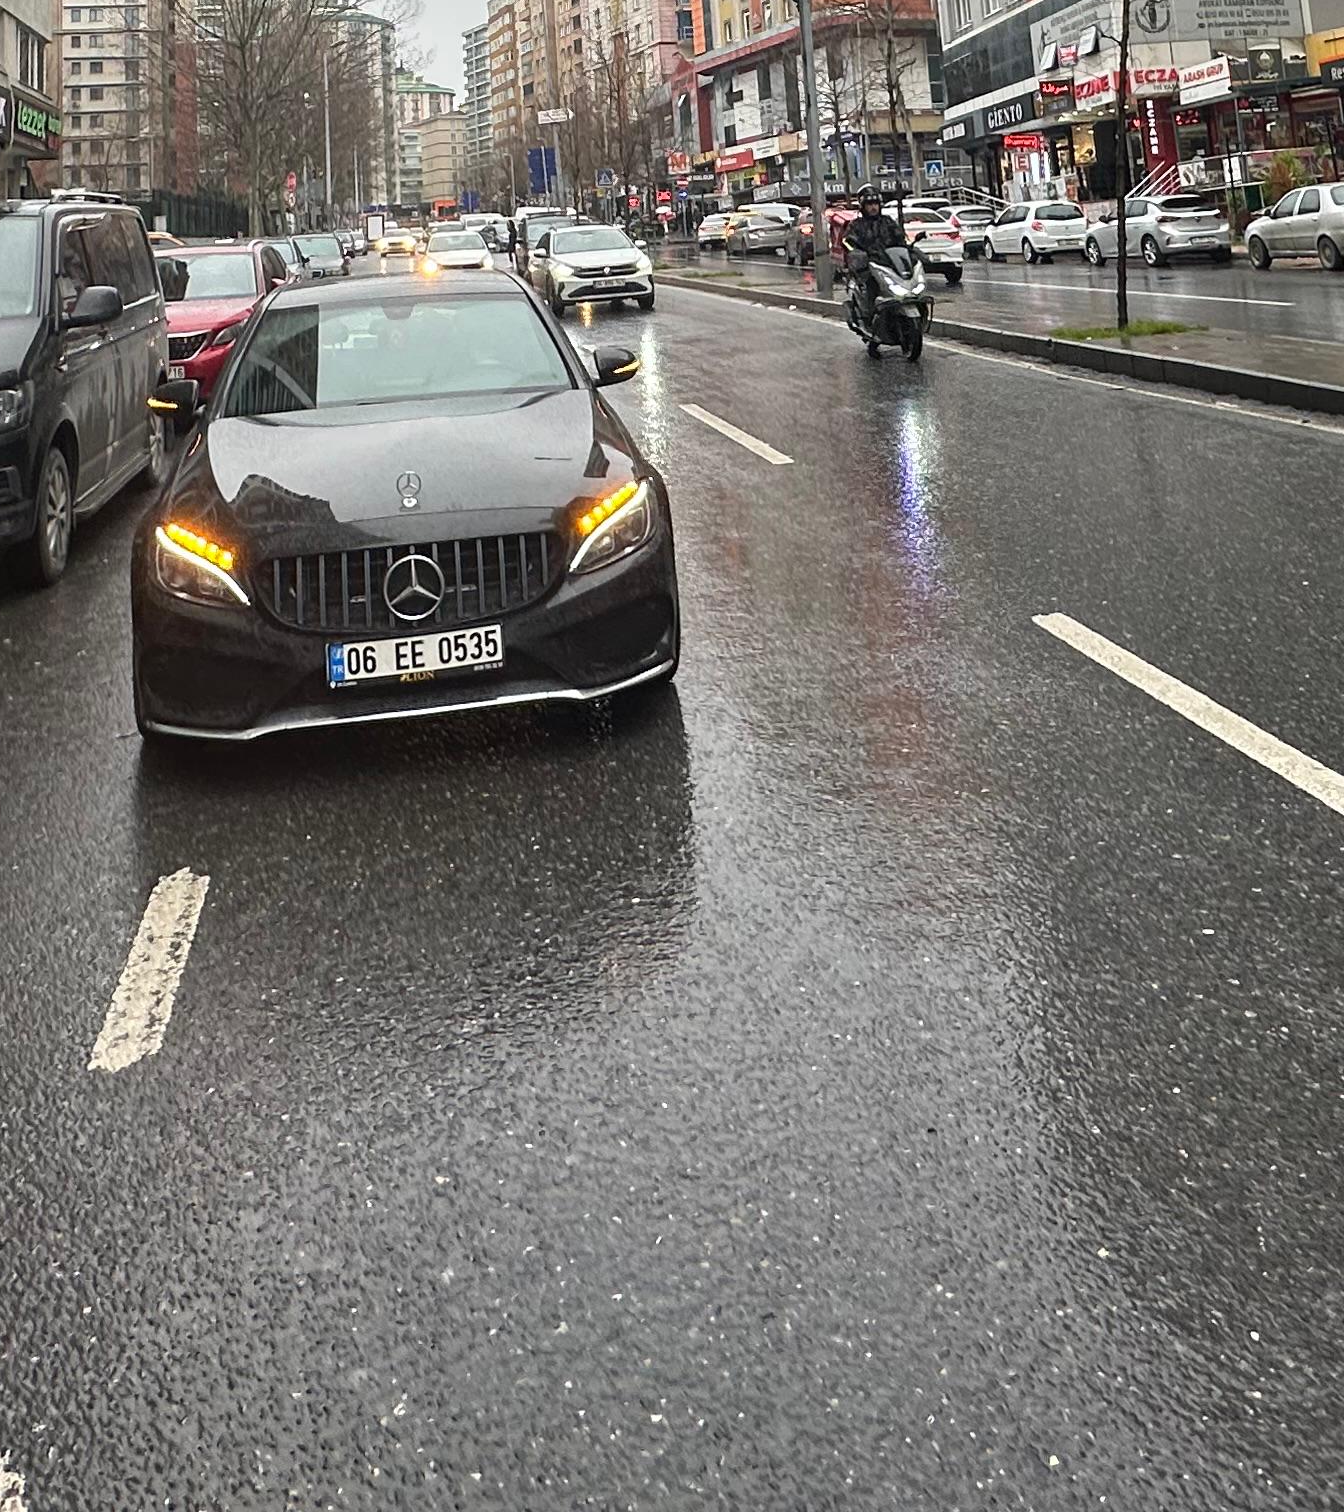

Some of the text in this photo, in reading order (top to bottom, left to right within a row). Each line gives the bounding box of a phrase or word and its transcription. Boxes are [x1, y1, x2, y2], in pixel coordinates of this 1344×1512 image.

[1134, 69, 1179, 84] ECZA
[881, 179, 909, 190] Fırn
[347, 629, 498, 676] 06 EE 0535
[332, 664, 344, 674] TR
